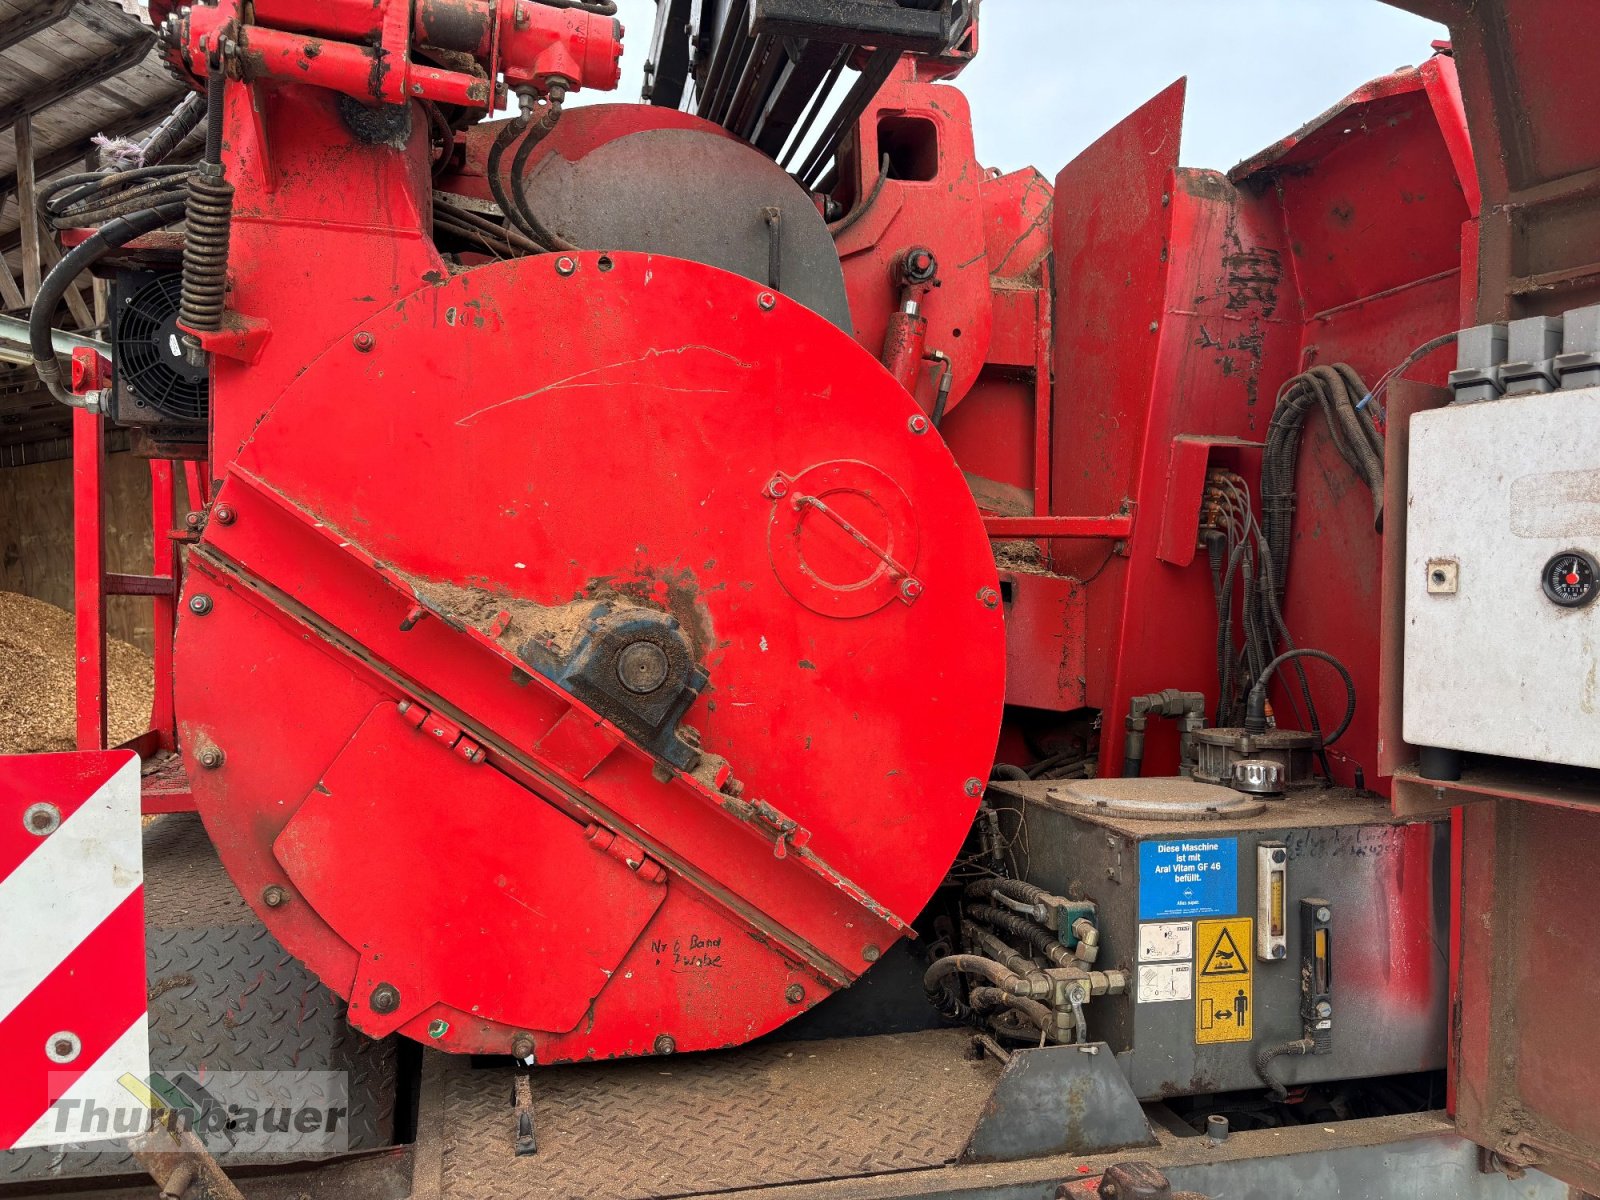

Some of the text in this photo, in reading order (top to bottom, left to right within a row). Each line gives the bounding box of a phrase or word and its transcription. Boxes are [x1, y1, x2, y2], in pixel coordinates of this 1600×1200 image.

[1157, 842, 1219, 853] Diese Maschine
[1176, 852, 1201, 862] ist mit
[1155, 861, 1221, 874] Aral Vitam GF 46
[1174, 873, 1202, 883] befüllt.
[689, 934, 722, 950] Band
